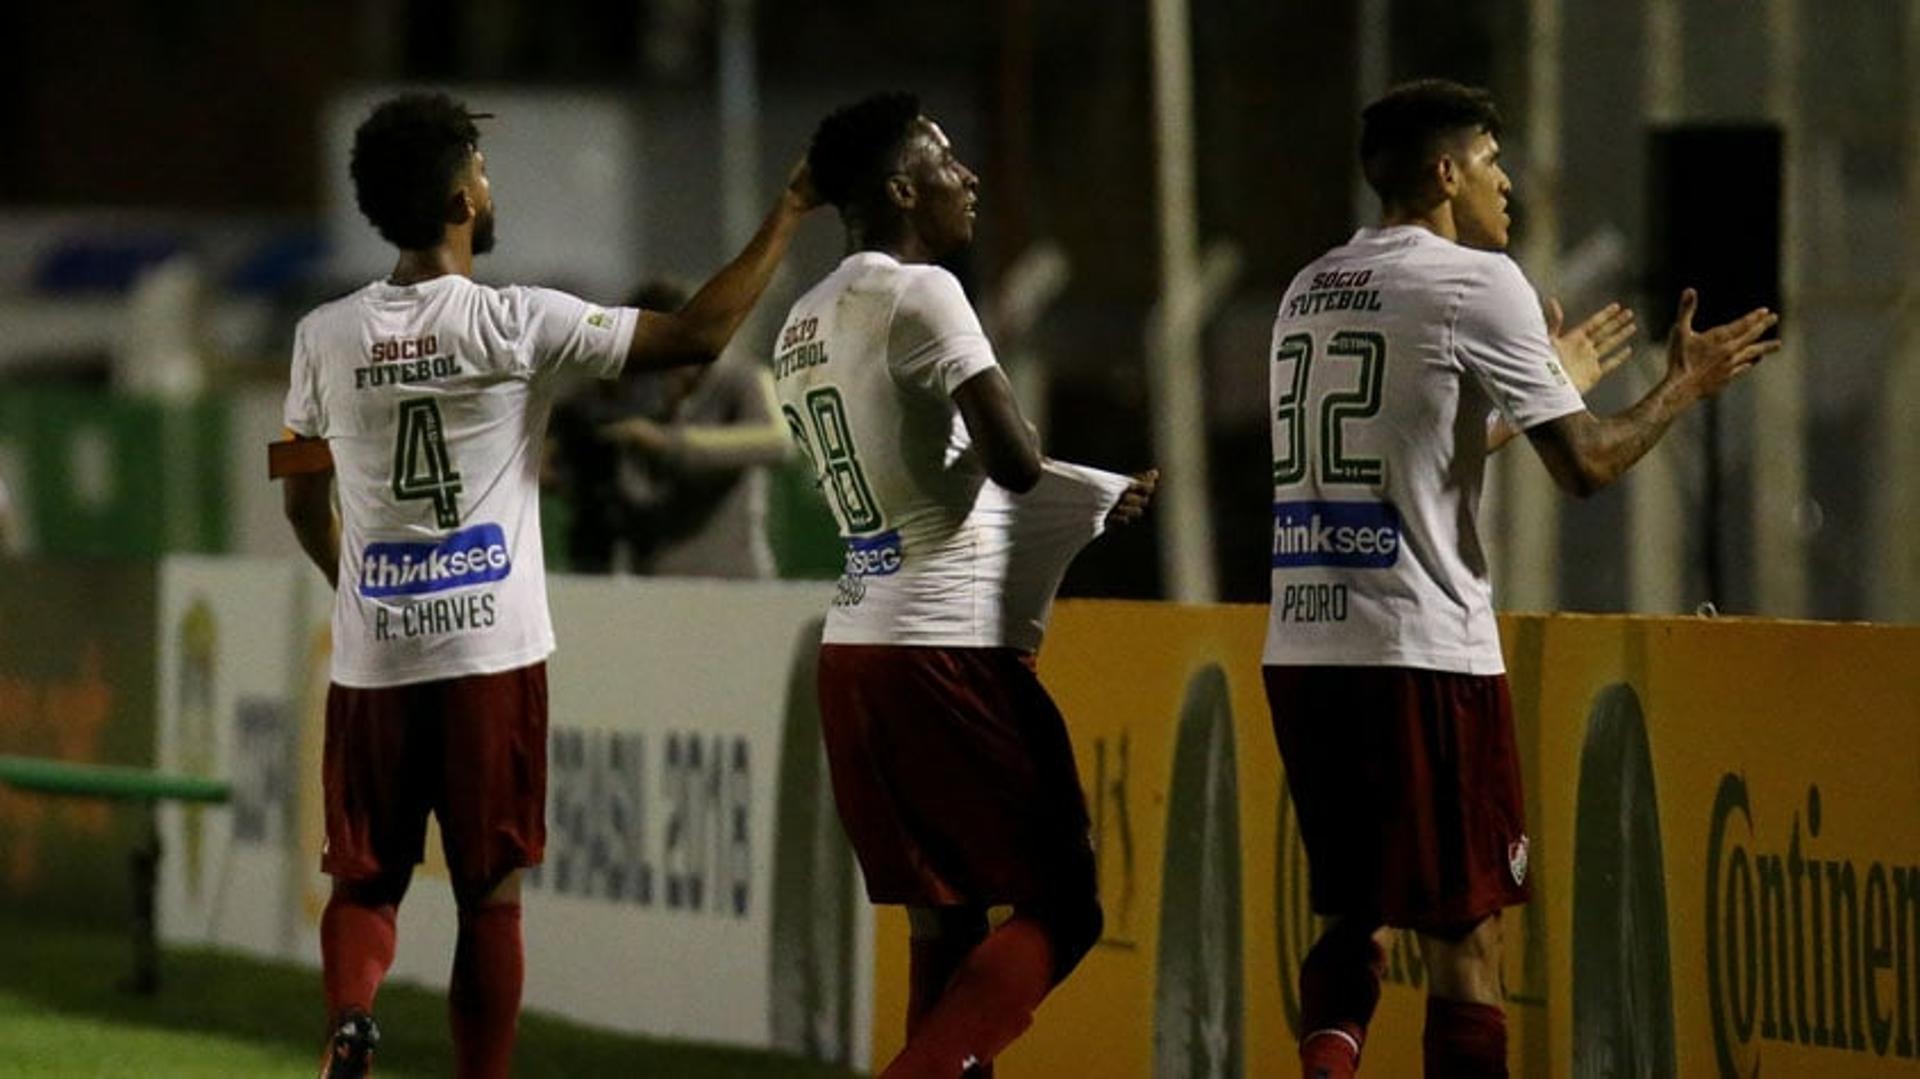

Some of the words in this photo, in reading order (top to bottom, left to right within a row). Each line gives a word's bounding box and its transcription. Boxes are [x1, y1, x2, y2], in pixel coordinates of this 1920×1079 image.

[1290, 288, 1382, 317] FUTEBOL
[371, 334, 438, 362] SÓCIO
[354, 354, 462, 389] FUTEBOL
[1273, 331, 1386, 485] 32
[392, 396, 462, 530] 4
[376, 606, 397, 641] R.
[403, 594, 496, 637] CHAVES
[1281, 583, 1348, 623] PEDRO
